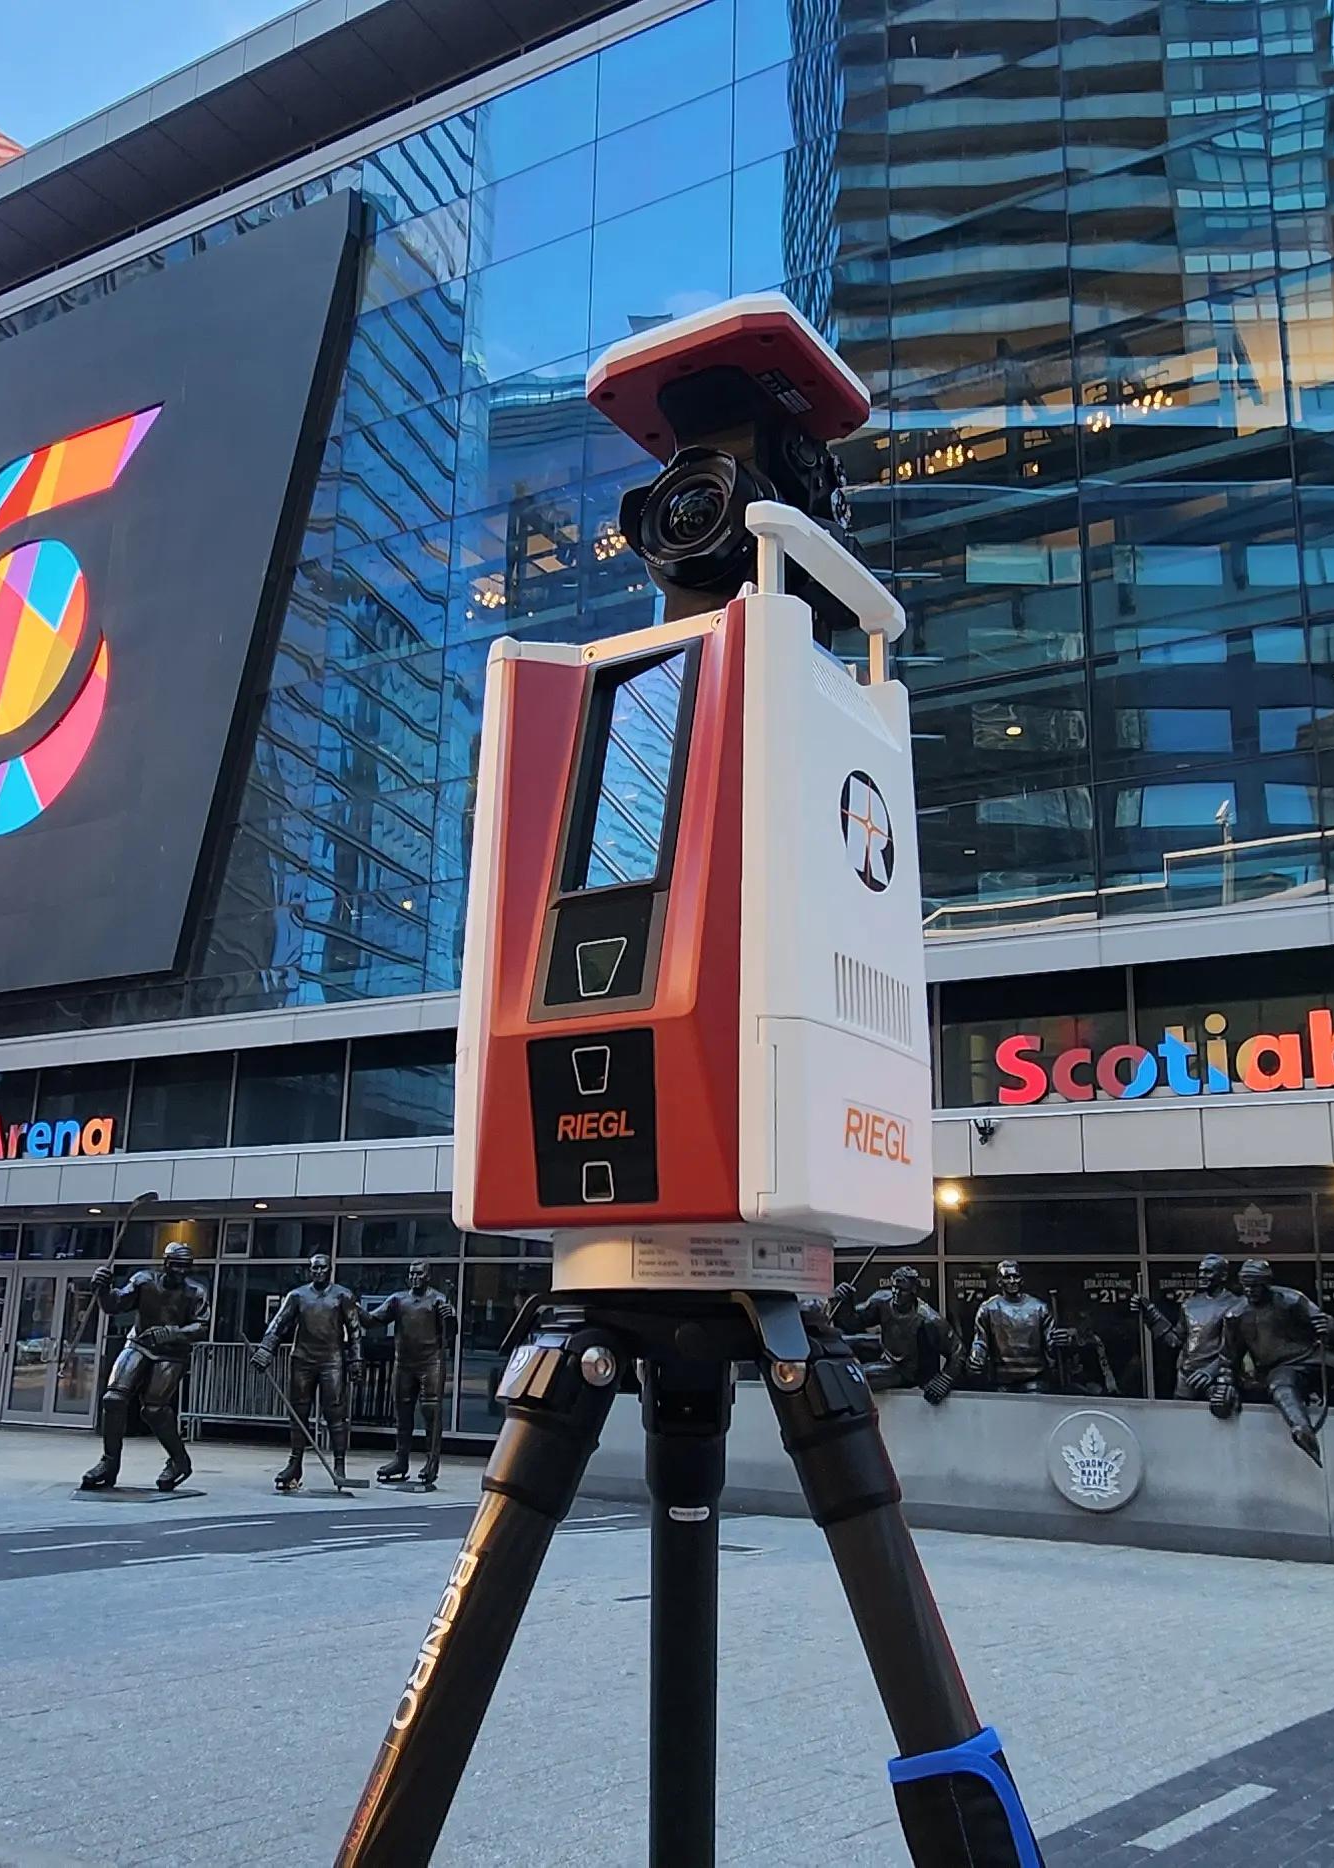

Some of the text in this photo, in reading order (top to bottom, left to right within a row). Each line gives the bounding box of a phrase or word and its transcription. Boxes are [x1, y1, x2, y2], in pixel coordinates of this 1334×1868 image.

[556, 1110, 636, 1142] RIEGL
[843, 1106, 912, 1166] RIEGL
[1099, 1289, 1117, 1303] 21
[1074, 1459, 1115, 1473] TORONTO
[1080, 1469, 1108, 1478] MAPLE
[1080, 1477, 1109, 1487] LEAFS
[391, 1550, 479, 1731] BENRO
